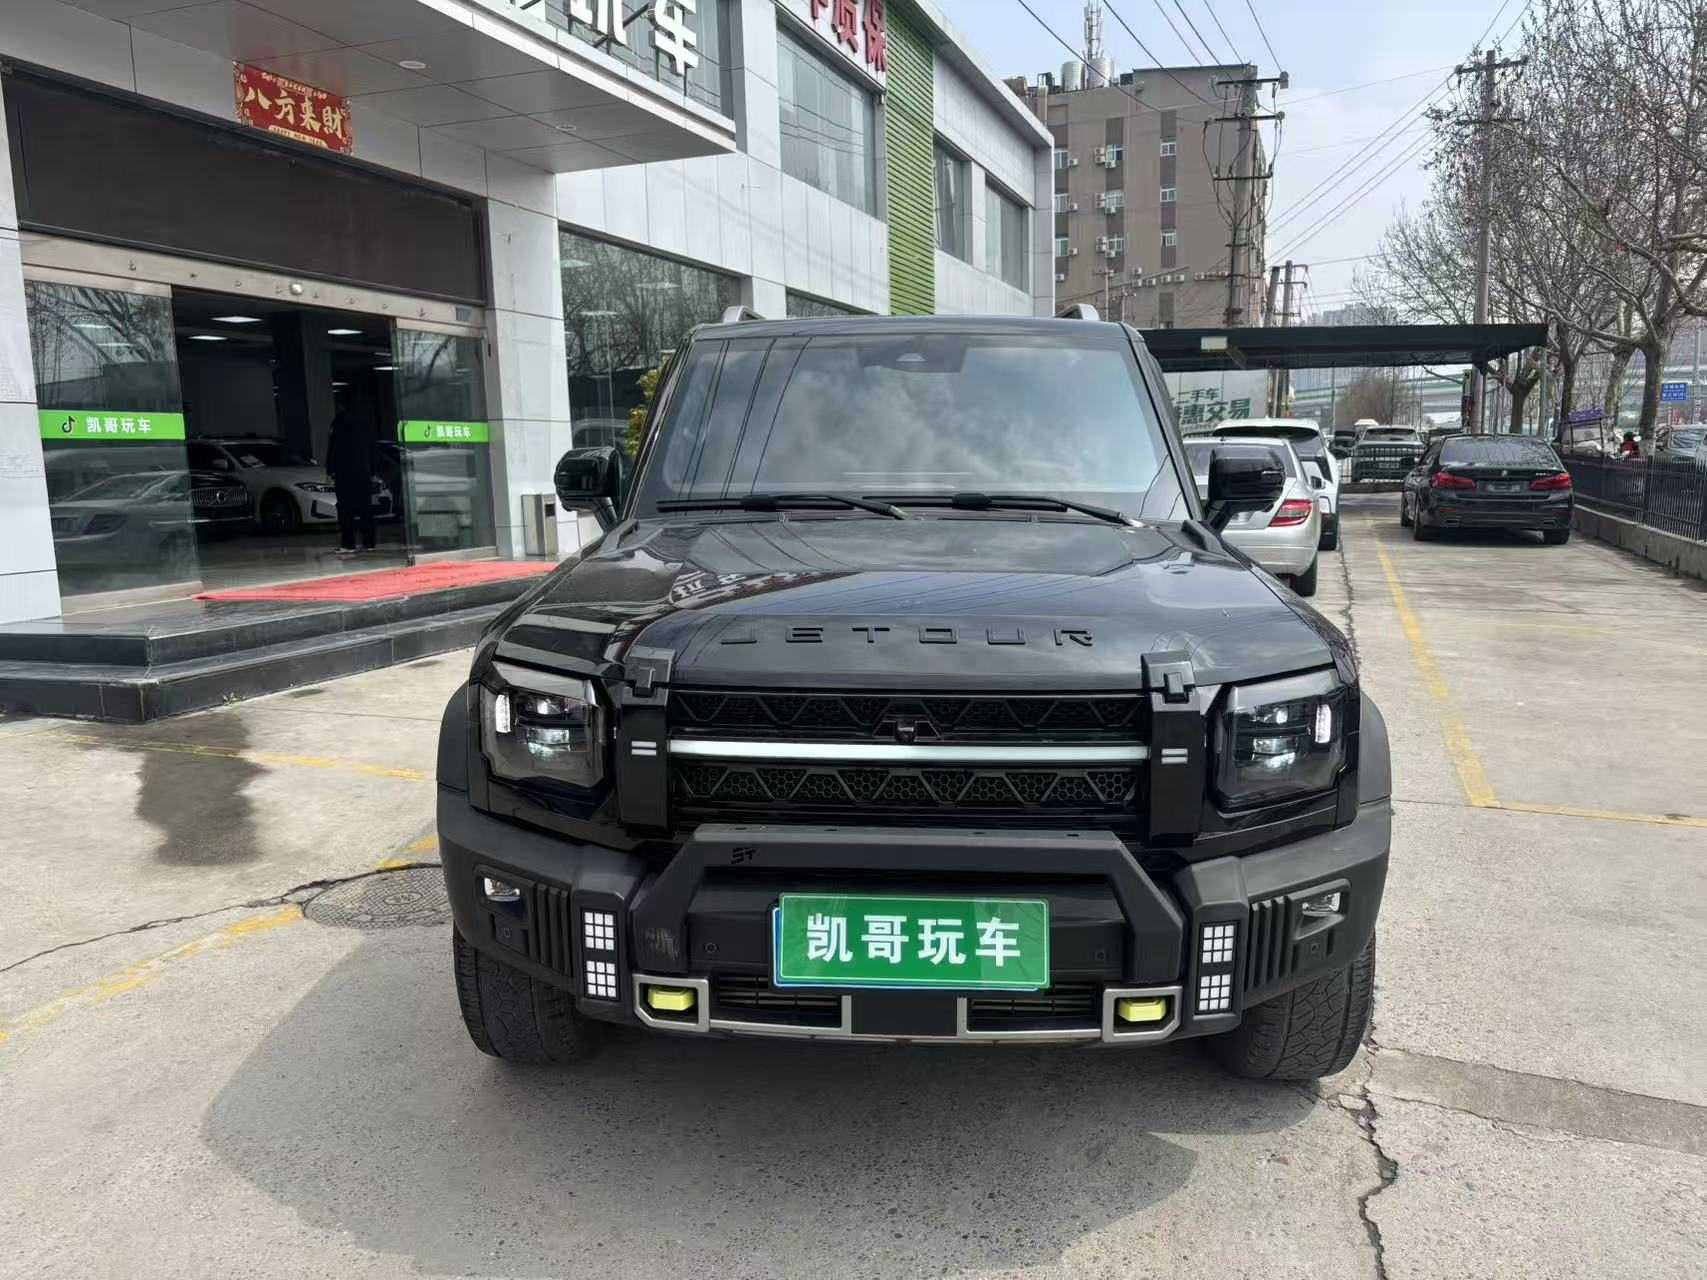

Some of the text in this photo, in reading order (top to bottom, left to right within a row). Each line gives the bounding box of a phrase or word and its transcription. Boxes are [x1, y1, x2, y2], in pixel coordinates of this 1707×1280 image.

[810, 0, 887, 72] 质保
[85, 416, 152, 433] 凯哥玩车
[720, 626, 1094, 647] JETOUR
[805, 912, 1022, 967] 凯哥玩车
